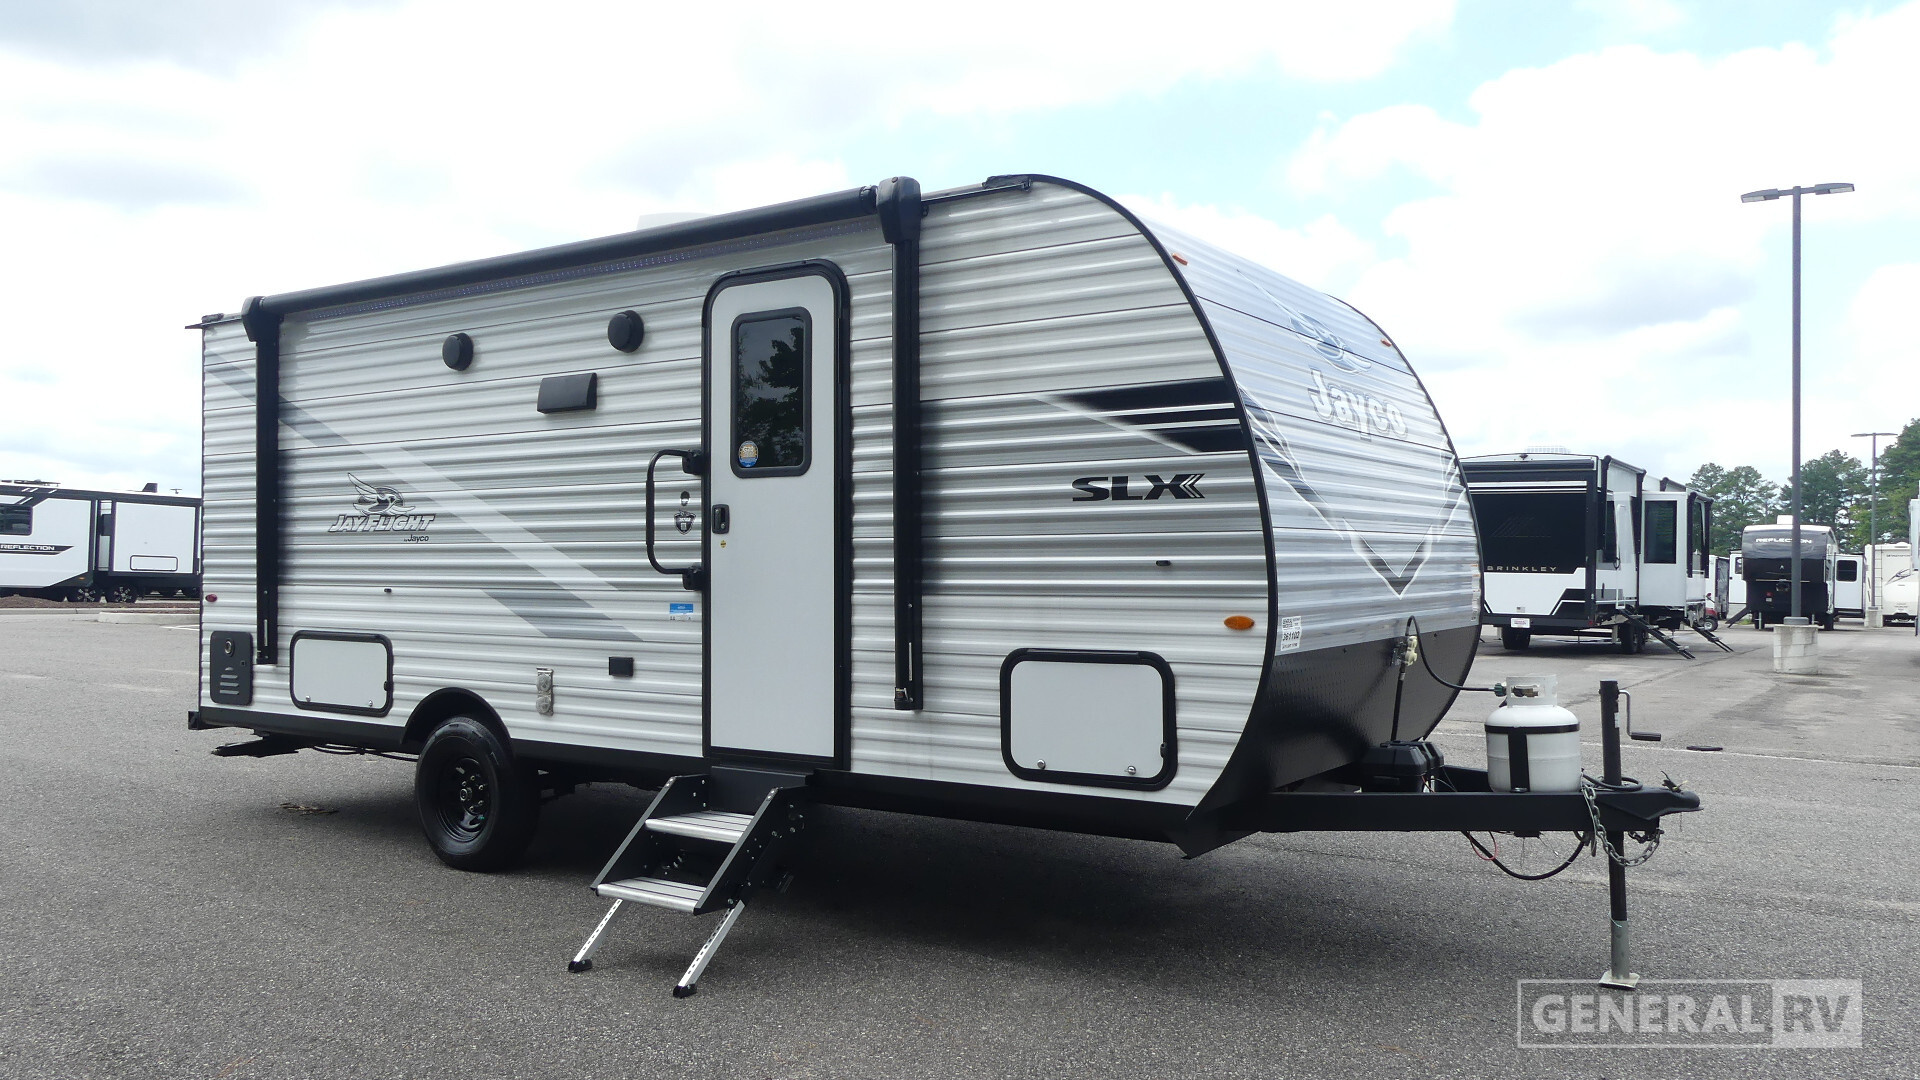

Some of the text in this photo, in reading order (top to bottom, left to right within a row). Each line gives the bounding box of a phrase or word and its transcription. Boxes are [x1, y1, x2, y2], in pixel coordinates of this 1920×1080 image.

[1307, 368, 1409, 441] Jayco
[1071, 473, 1206, 502] SLX
[407, 534, 430, 544] Jayco
